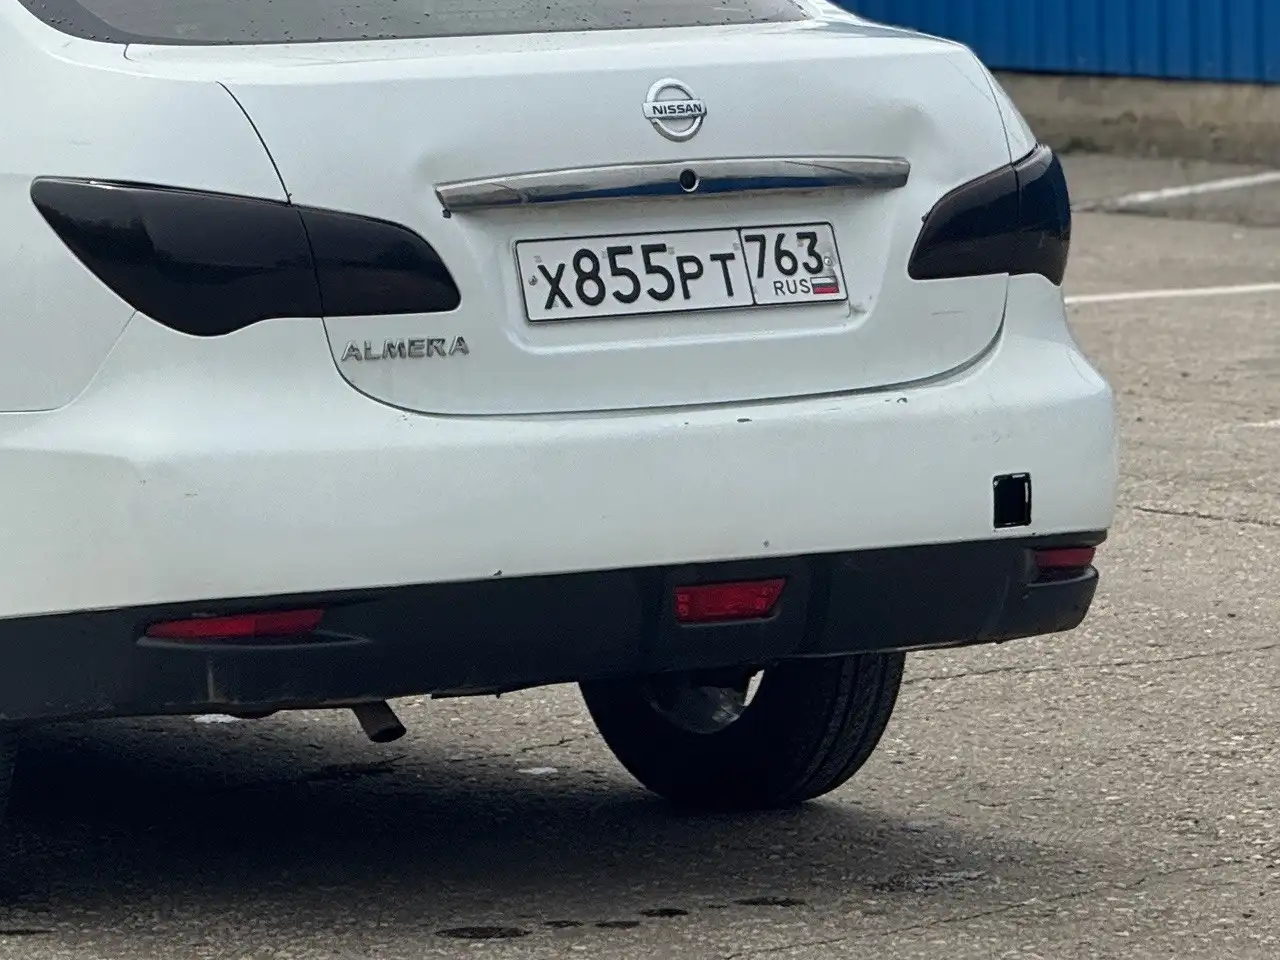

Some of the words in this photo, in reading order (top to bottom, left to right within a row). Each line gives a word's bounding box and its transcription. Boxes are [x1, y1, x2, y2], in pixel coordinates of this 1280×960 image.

[652, 103, 702, 115] NISSAN
[744, 231, 824, 279] 763
[773, 278, 811, 296] RUS
[341, 335, 470, 362] ALMERA
